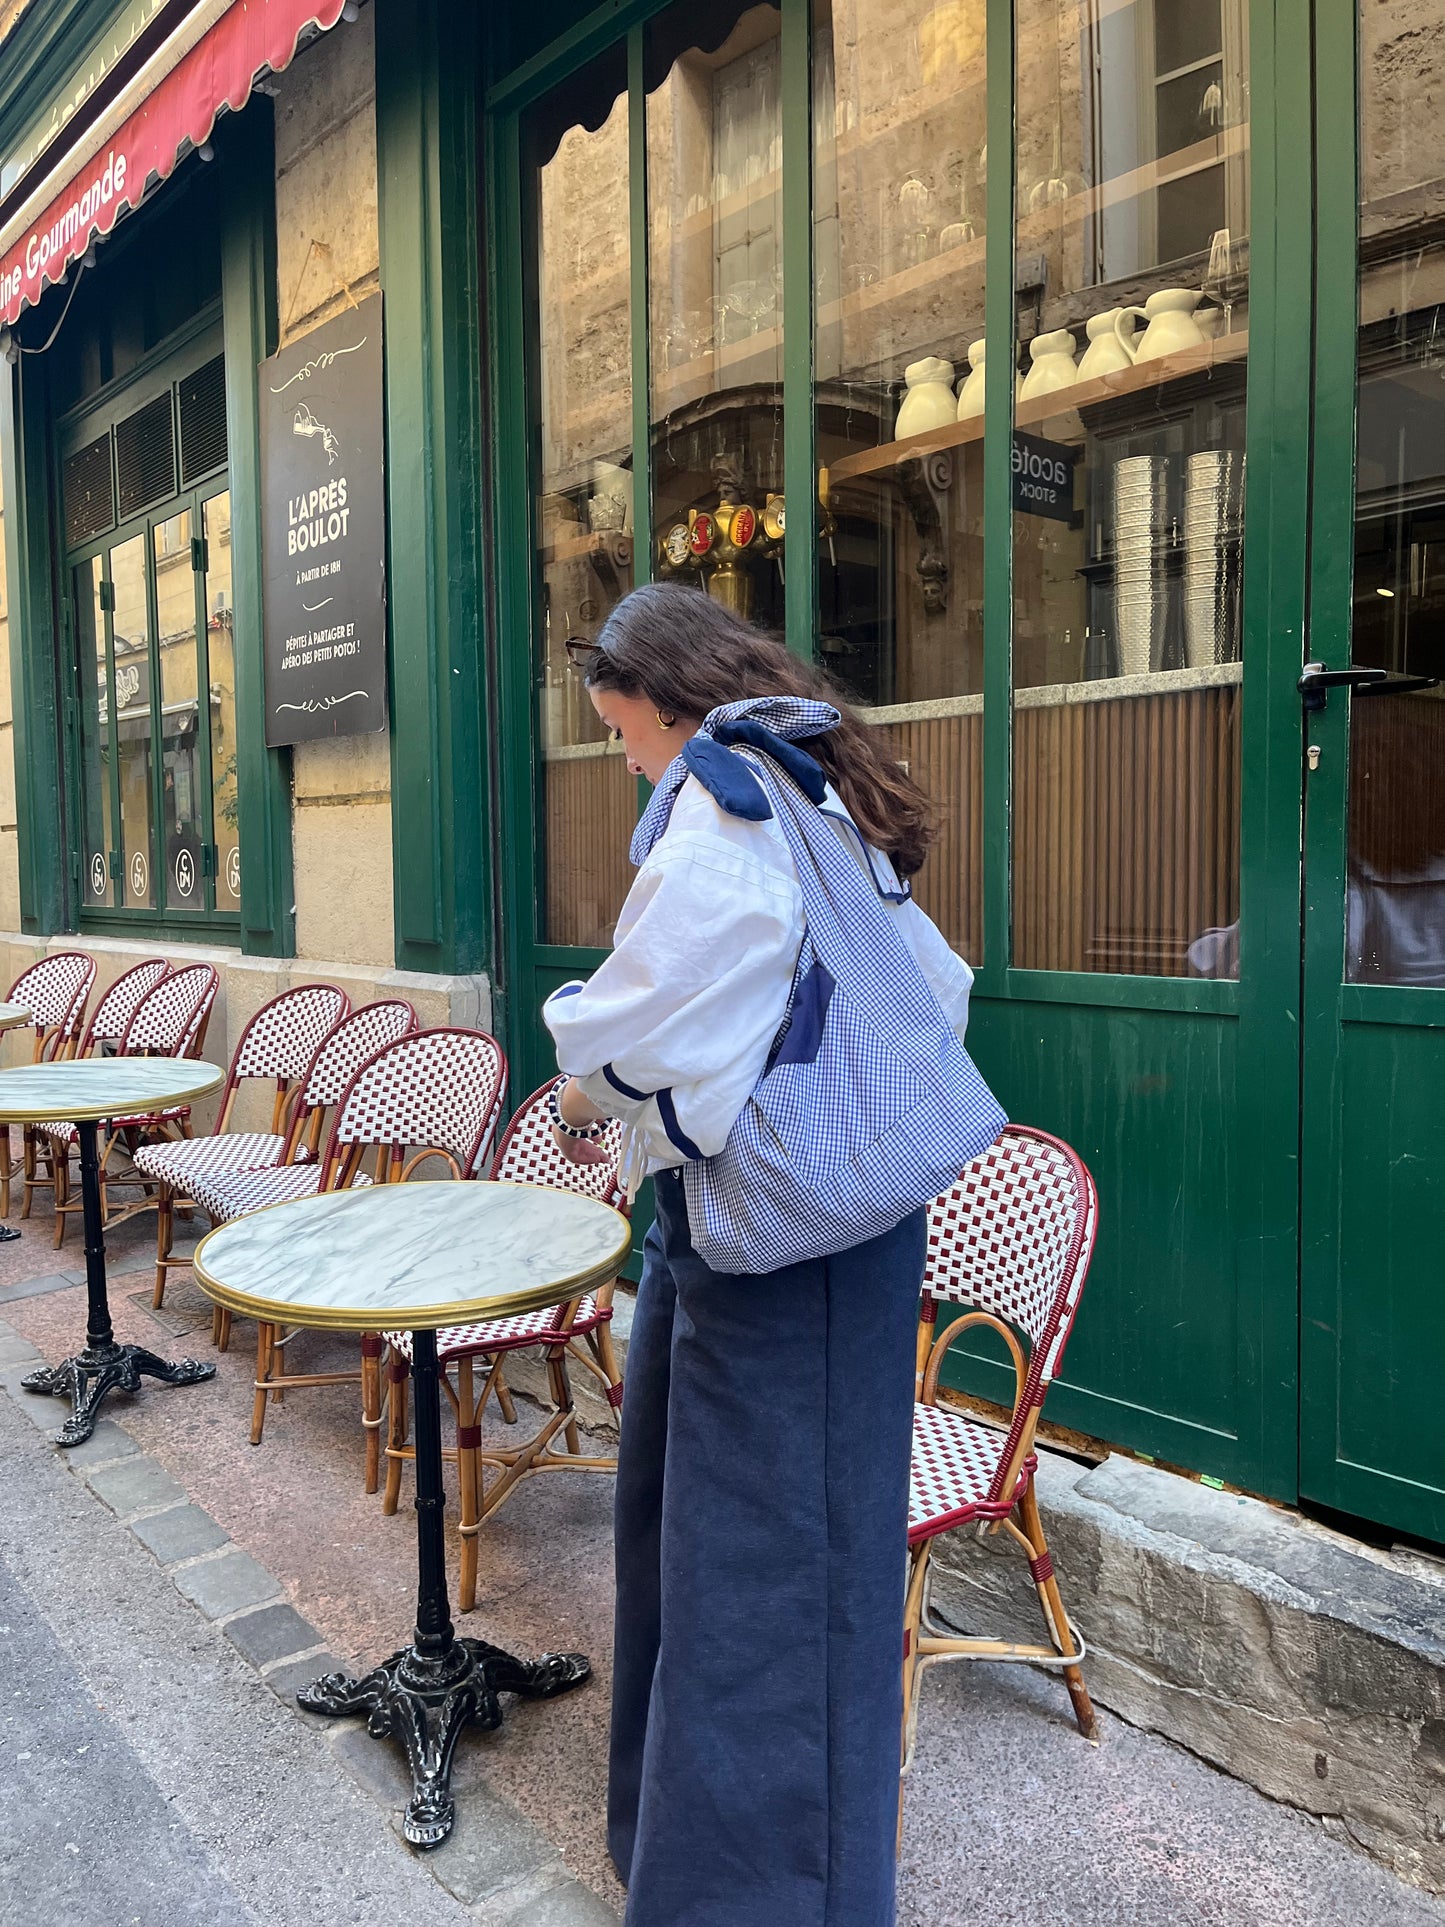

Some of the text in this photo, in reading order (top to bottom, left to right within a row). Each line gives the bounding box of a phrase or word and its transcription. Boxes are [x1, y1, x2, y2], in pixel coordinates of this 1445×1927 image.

[26, 150, 127, 279] Gourmande
[288, 477, 347, 526] L'APRÈS
[288, 507, 350, 556] BOULOT
[296, 560, 341, 585] À PARTIR DE 18H
[285, 622, 355, 652] PÉPITES À PARTAGER ET
[281, 653, 301, 670] APÉRO
[301, 650, 313, 666] DES
[313, 646, 333, 663] PETITS
[333, 640, 356, 658] POTOS
[95, 857, 102, 873] C
[135, 857, 142, 873] C
[181, 854, 188, 872] C
[232, 852, 240, 870] C
